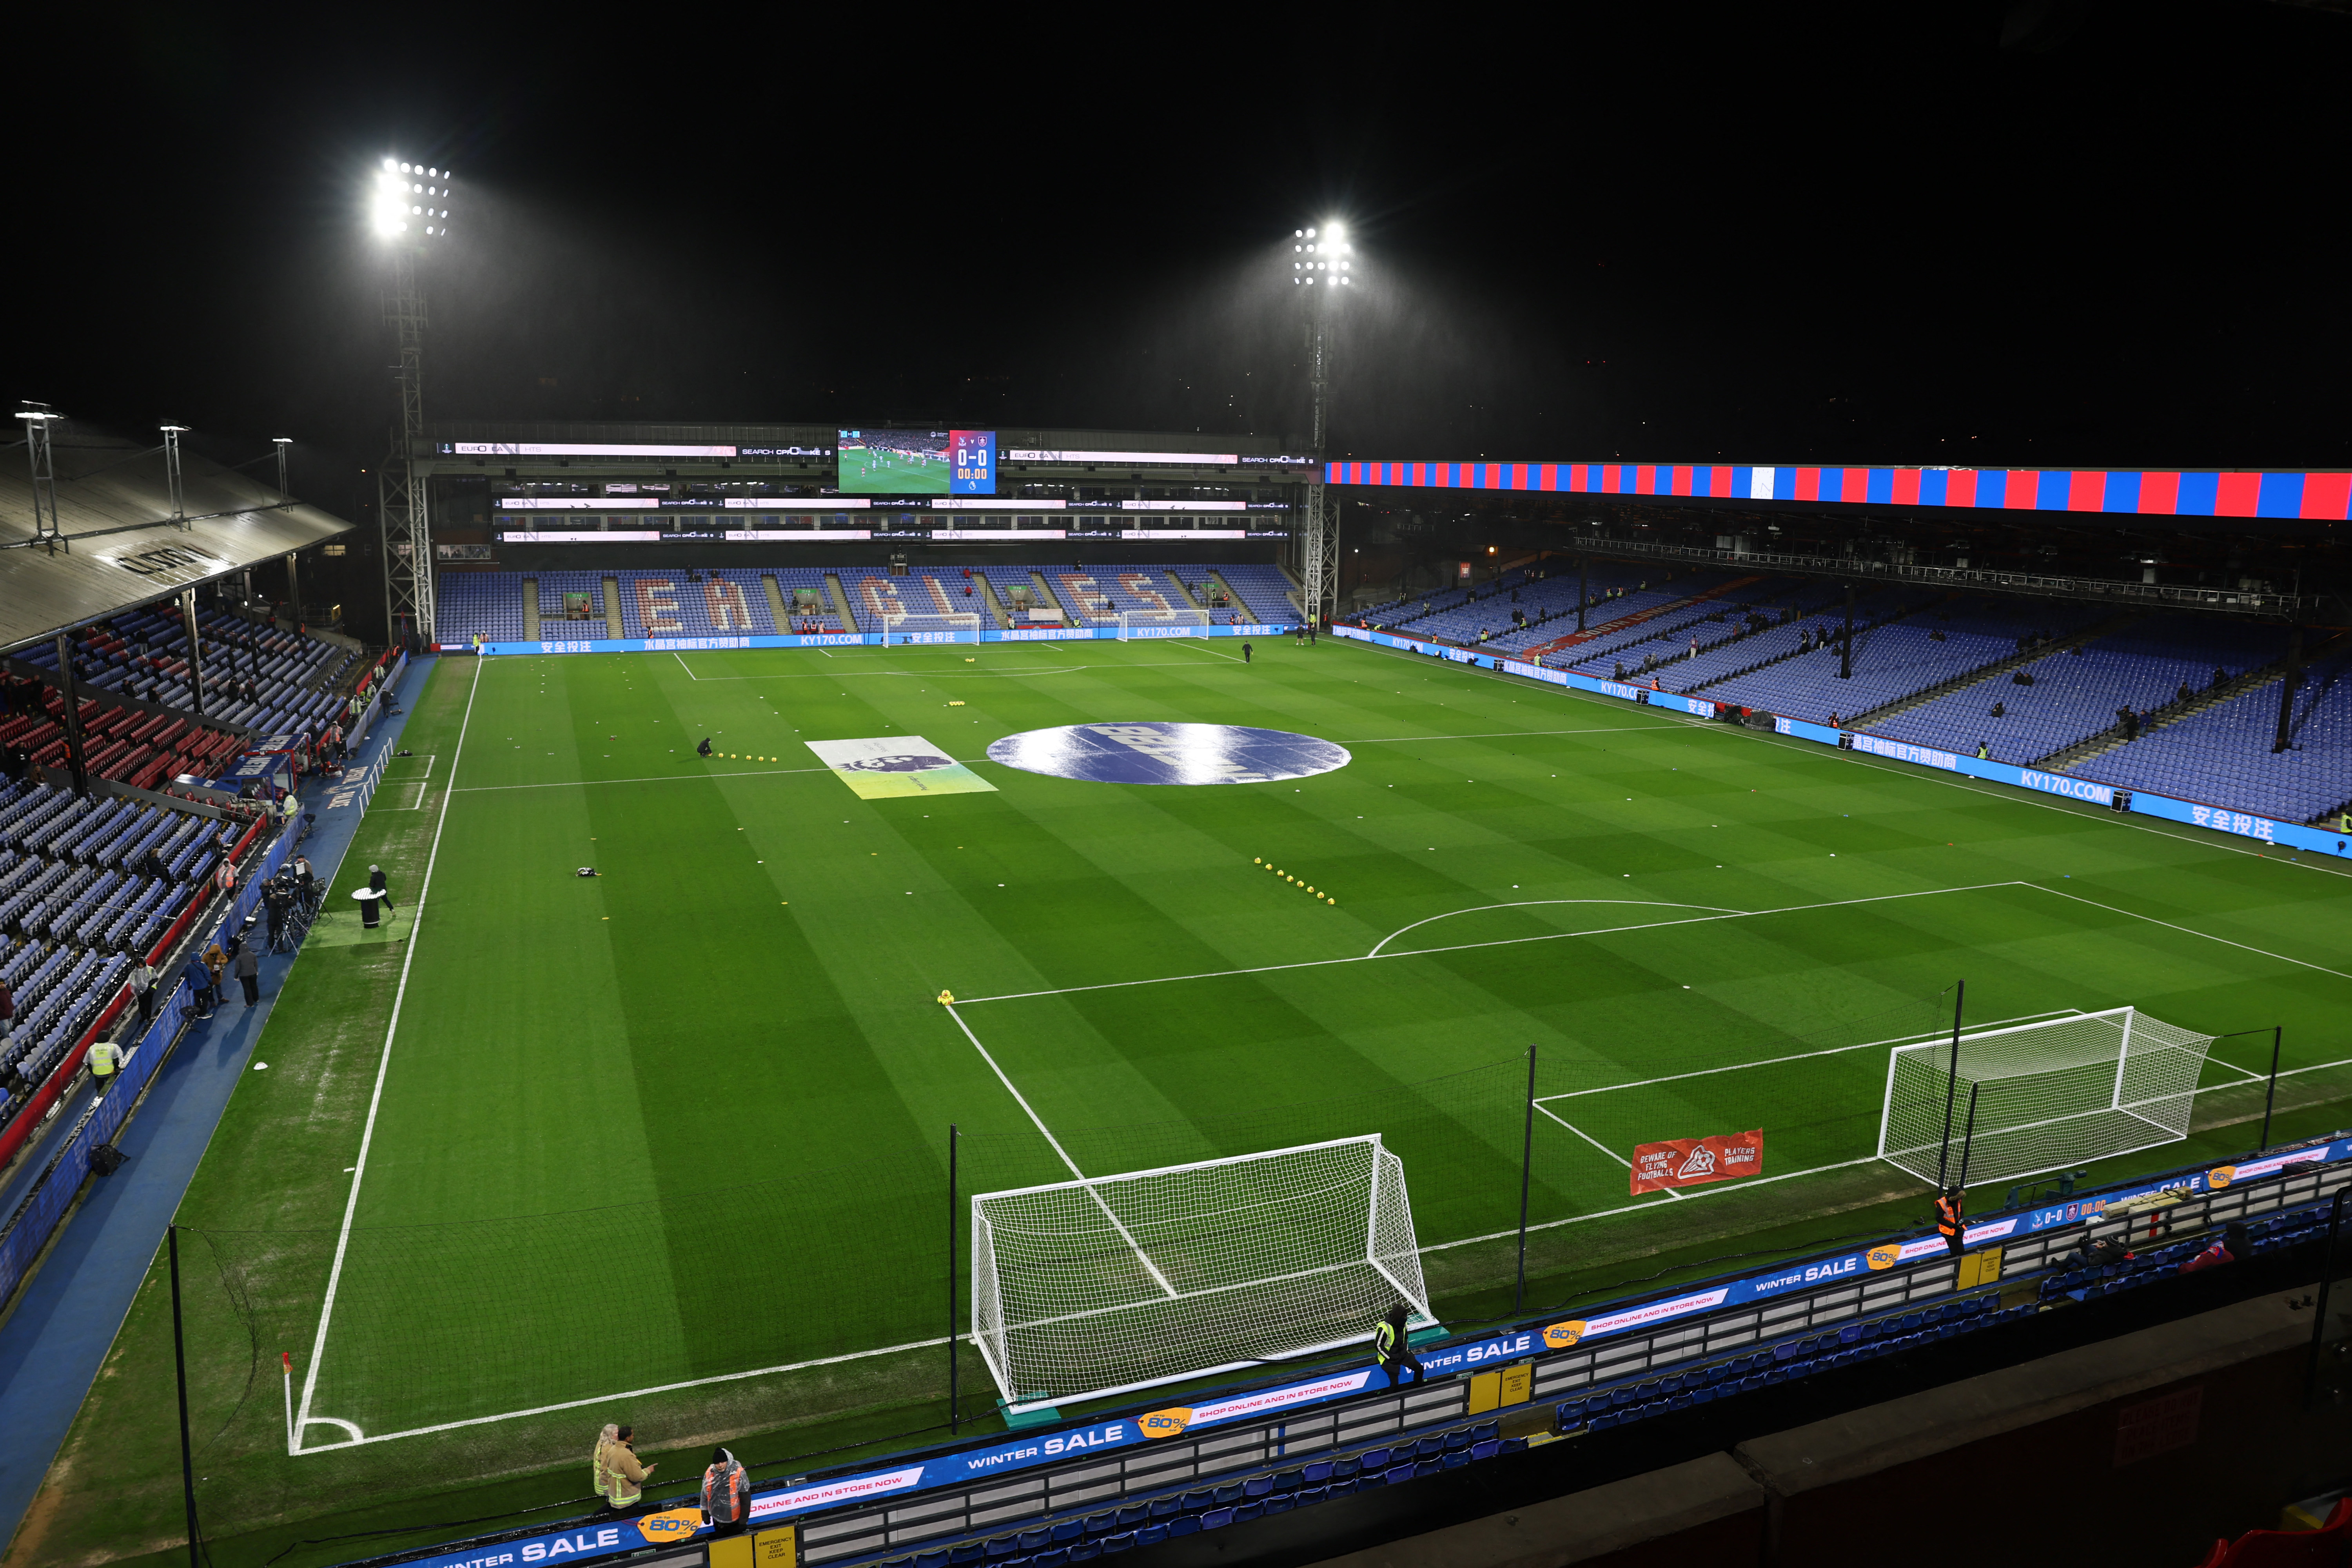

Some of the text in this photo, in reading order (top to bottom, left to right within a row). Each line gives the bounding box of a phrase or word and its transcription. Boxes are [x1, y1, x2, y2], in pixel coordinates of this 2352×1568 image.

[958, 449, 987, 466] 0-0
[958, 468, 987, 479] 00:00
[1575, 620, 1630, 638] SOUTH
[1628, 599, 1693, 621] LONDON
[1137, 627, 1191, 637] KY170.COM
[1233, 624, 1270, 635] 安全投注
[801, 634, 862, 645] KY170.COM
[911, 632, 955, 643] 安全投注
[541, 641, 592, 653] 安全投注
[1853, 734, 1957, 770] 晶宫袖标官方赞助商
[2021, 770, 2111, 803] KY170.COM
[2192, 805, 2274, 841] 安全投注
[1640, 1152, 1666, 1164] BEWARE
[1724, 1147, 1755, 1156] PLAYERS
[1646, 1160, 1667, 1171] FLYING
[1724, 1155, 1755, 1166] TRAINING
[1637, 1168, 1673, 1181] FOOTBALLS
[2045, 1209, 2063, 1223] 0-0
[1924, 1241, 1947, 1250] ONLINE
[1969, 1230, 1990, 1239] STORE
[1872, 1252, 1896, 1262] 80%
[1756, 1258, 1857, 1291] WINTER SALE
[1615, 1316, 1642, 1325] ONLINE
[1670, 1302, 1694, 1312] STORE
[1695, 1296, 1714, 1305] NOW
[1550, 1329, 1581, 1339] 80%
[1405, 1336, 1530, 1374] WNTER SALE
[1505, 1373, 1529, 1381] EMERGENCY
[1200, 1408, 1226, 1418] SHOP
[1228, 1401, 1263, 1412] ONLINE
[1264, 1396, 1285, 1405] AND
[1298, 1386, 1328, 1398] STORE
[1330, 1380, 1353, 1389] NOW
[2123, 1403, 2161, 1426] PLEASE
[2164, 1398, 2177, 1414] DO
[1147, 1417, 1186, 1428] 80%
[968, 1425, 1123, 1469] WINTER SALE
[750, 1499, 791, 1513] ONLINE
[794, 1494, 819, 1504] AND
[835, 1483, 873, 1495] STORE
[875, 1477, 902, 1487] NOW
[649, 1519, 698, 1532] 80%
[522, 1528, 620, 1562] SALE
[759, 1537, 792, 1547] EMERGENCY
